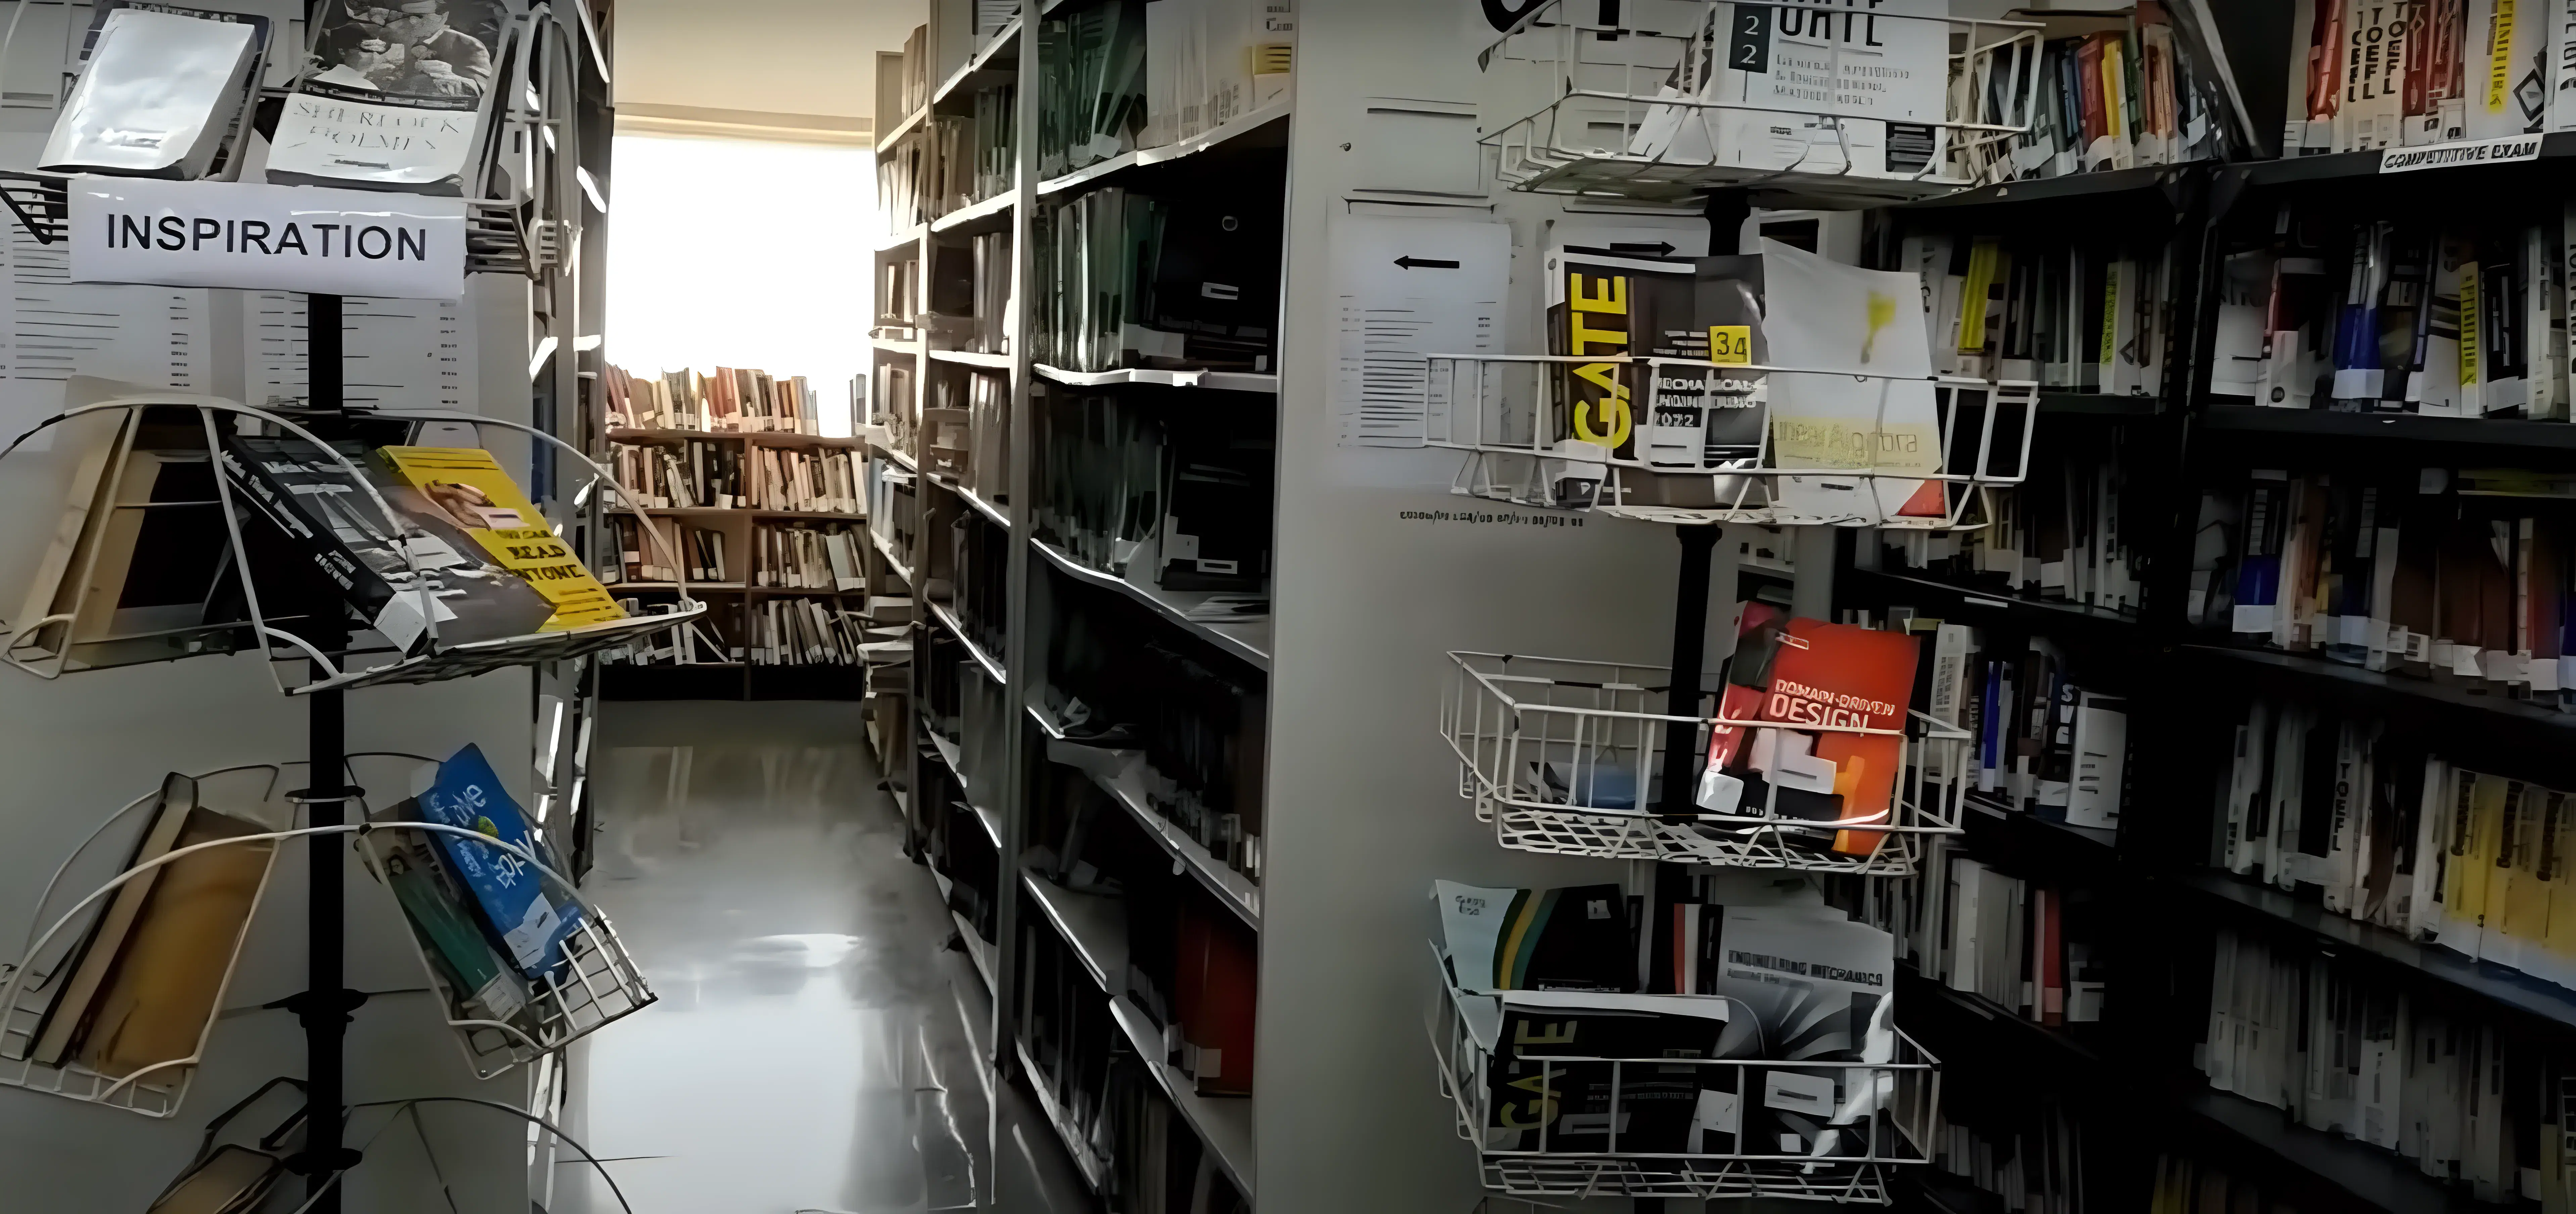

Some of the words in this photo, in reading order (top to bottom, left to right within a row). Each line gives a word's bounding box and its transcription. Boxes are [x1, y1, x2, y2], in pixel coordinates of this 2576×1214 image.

[2362, 7, 2384, 99] TOEFL
[2383, 1, 2408, 94] TOEFL
[108, 213, 426, 261] INSPIRATION
[1571, 272, 1632, 449] GATE
[1769, 693, 1869, 729] DESIGN
